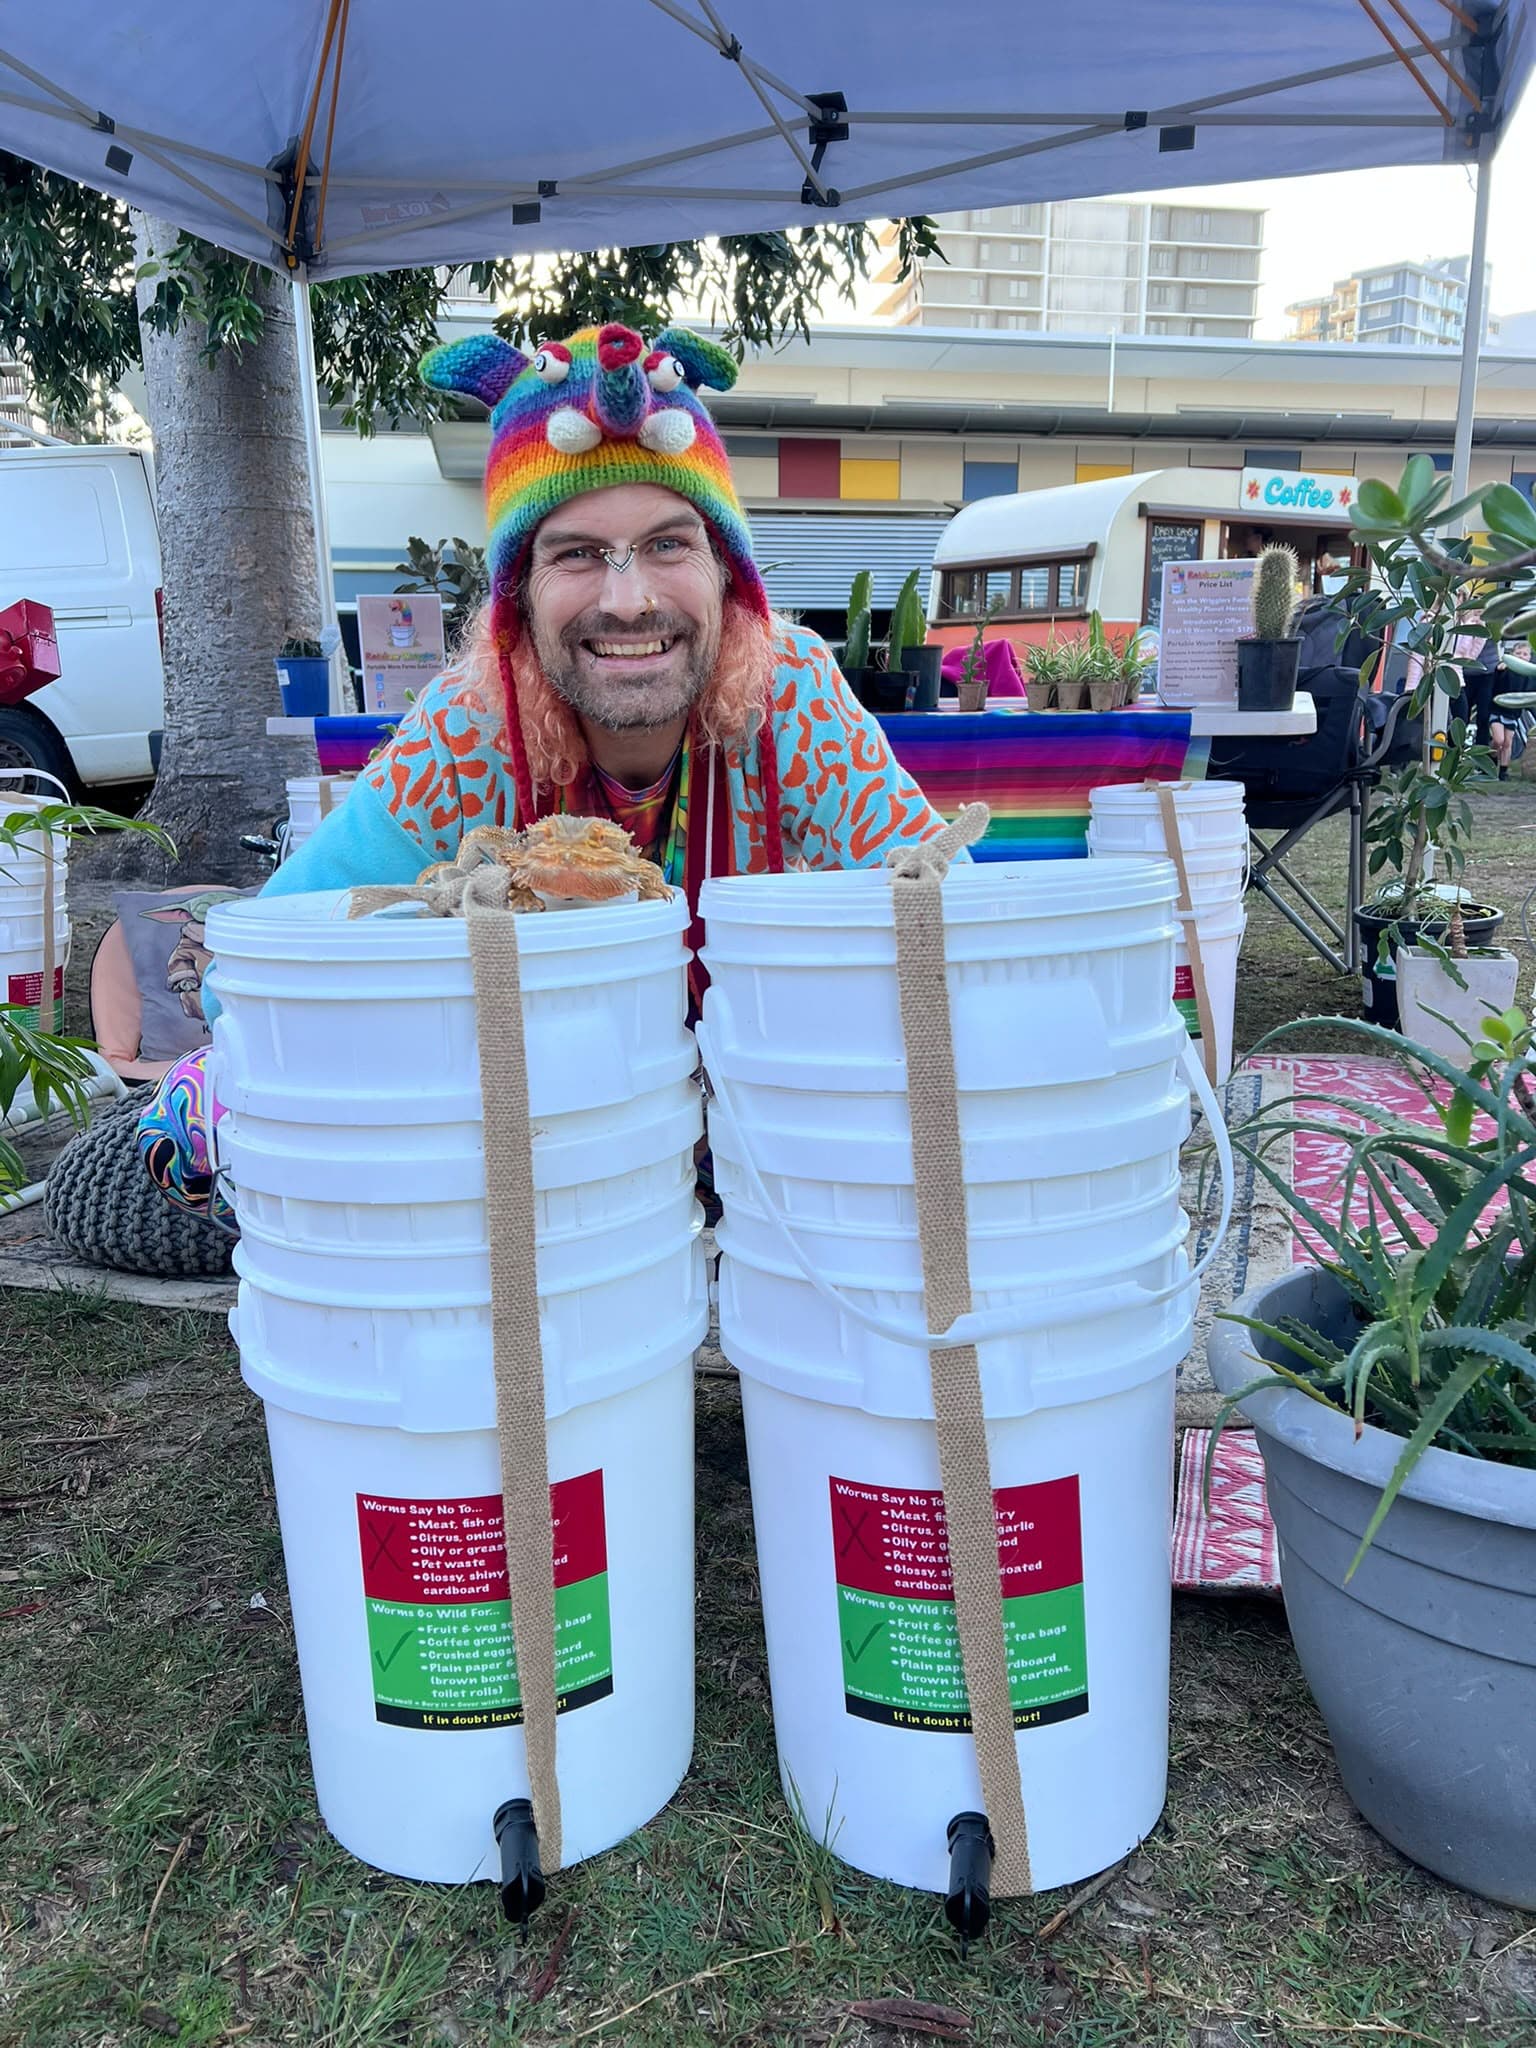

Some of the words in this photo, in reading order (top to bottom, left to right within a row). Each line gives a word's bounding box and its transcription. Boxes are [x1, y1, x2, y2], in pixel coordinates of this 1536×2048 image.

[1264, 476, 1335, 509] Coffee
[1199, 581, 1217, 589] Price
[836, 1483, 879, 1501] Worms
[881, 1493, 906, 1506] Say
[909, 1495, 927, 1506] No
[362, 1500, 406, 1514] Worms
[409, 1505, 433, 1517] Say
[437, 1505, 455, 1515] No
[890, 1509, 931, 1522] Meat,
[418, 1520, 458, 1530] Meat,
[462, 1518, 485, 1528] fish
[488, 1517, 502, 1525] or
[891, 1522, 935, 1536] Citrus,
[997, 1521, 1035, 1535] garlic
[419, 1533, 463, 1543] Citrus,
[892, 1536, 917, 1549] Oily
[921, 1541, 935, 1549] or
[995, 1536, 1018, 1548] ood
[420, 1546, 446, 1557] Oily
[449, 1547, 464, 1555] or
[892, 1550, 914, 1561] Pet
[916, 1554, 950, 1563] wast
[421, 1559, 442, 1569] Pet
[444, 1558, 486, 1569] waste
[893, 1563, 937, 1578] Glossy,
[999, 1560, 1043, 1575] coated
[422, 1572, 466, 1583] Glossy,
[469, 1570, 505, 1580] shiny
[423, 1584, 490, 1596] cardboard
[894, 1579, 954, 1591] cardboar
[843, 1590, 886, 1609] Worms
[888, 1601, 905, 1611] Go
[908, 1603, 939, 1615] Wild
[371, 1603, 414, 1617] Worms
[417, 1608, 433, 1618] Go
[436, 1608, 467, 1618] Wild
[426, 1624, 459, 1634] Fruit
[461, 1624, 471, 1633] &
[474, 1623, 497, 1633] veg
[427, 1637, 470, 1647] Coffee
[565, 1612, 592, 1629] bags
[897, 1618, 930, 1631] Fruit
[933, 1622, 943, 1631] &
[898, 1632, 942, 1645] Coffee
[1014, 1632, 1036, 1641] tea
[1039, 1624, 1068, 1637] bags
[428, 1649, 480, 1660] Crushed
[899, 1645, 952, 1659] Crushed
[429, 1662, 462, 1673] Plain
[465, 1661, 503, 1674] paper
[900, 1657, 933, 1671] Plain
[1007, 1653, 1057, 1670] rdboard
[430, 1676, 478, 1686] (brown
[901, 1671, 949, 1685] (brown
[432, 1688, 467, 1698] toilet
[470, 1685, 504, 1697] rolls)
[902, 1686, 937, 1698] toilet
[481, 1699, 501, 1707] with
[928, 1701, 950, 1709] Cover
[423, 1714, 434, 1724] If
[437, 1715, 449, 1725] in
[452, 1714, 489, 1726] doubt
[893, 1711, 904, 1722] If
[907, 1713, 920, 1723] in
[923, 1716, 960, 1727] doubt
[1014, 1711, 1041, 1724] out!
